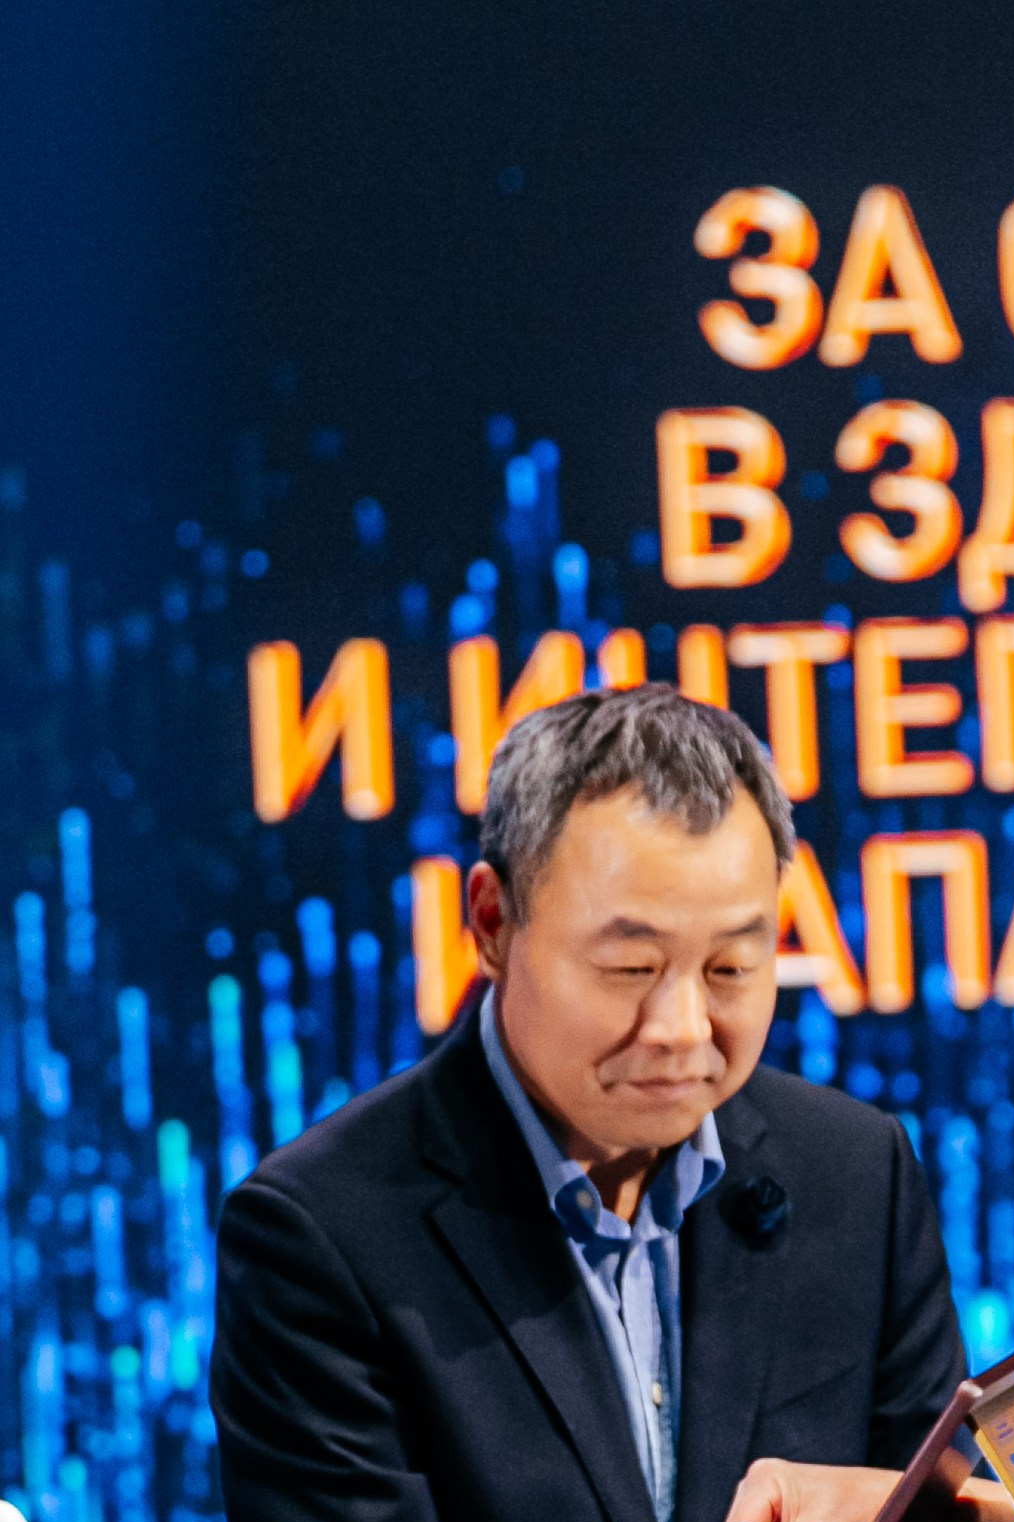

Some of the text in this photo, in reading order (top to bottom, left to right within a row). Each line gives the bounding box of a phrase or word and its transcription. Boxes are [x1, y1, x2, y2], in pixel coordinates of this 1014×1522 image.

[694, 184, 963, 370] ЗА
[655, 404, 793, 592] В
[246, 636, 396, 824] И
